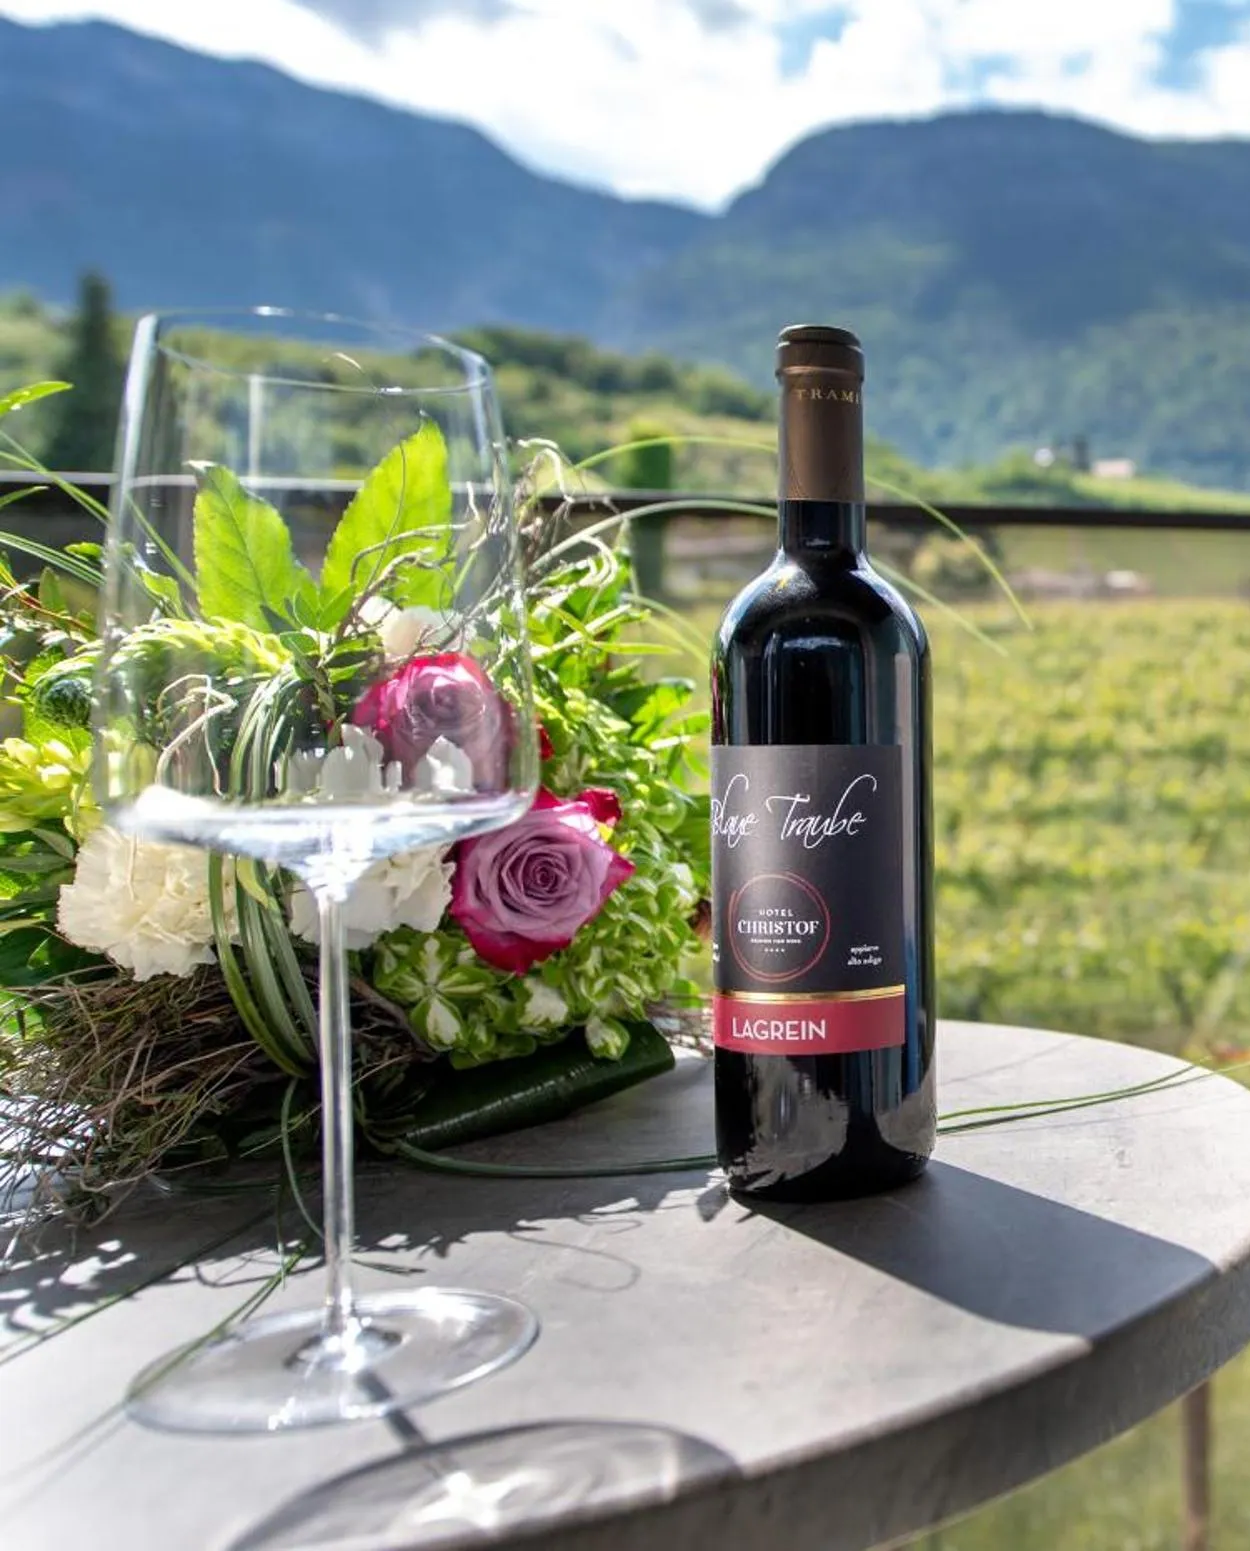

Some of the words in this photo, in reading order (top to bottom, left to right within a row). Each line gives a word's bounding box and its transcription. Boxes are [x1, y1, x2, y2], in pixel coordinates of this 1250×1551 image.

[766, 774, 878, 849] Traube
[759, 908, 794, 917] HOTEL
[737, 919, 820, 935] CHRISTOF
[732, 1017, 826, 1041] LAGREIN
